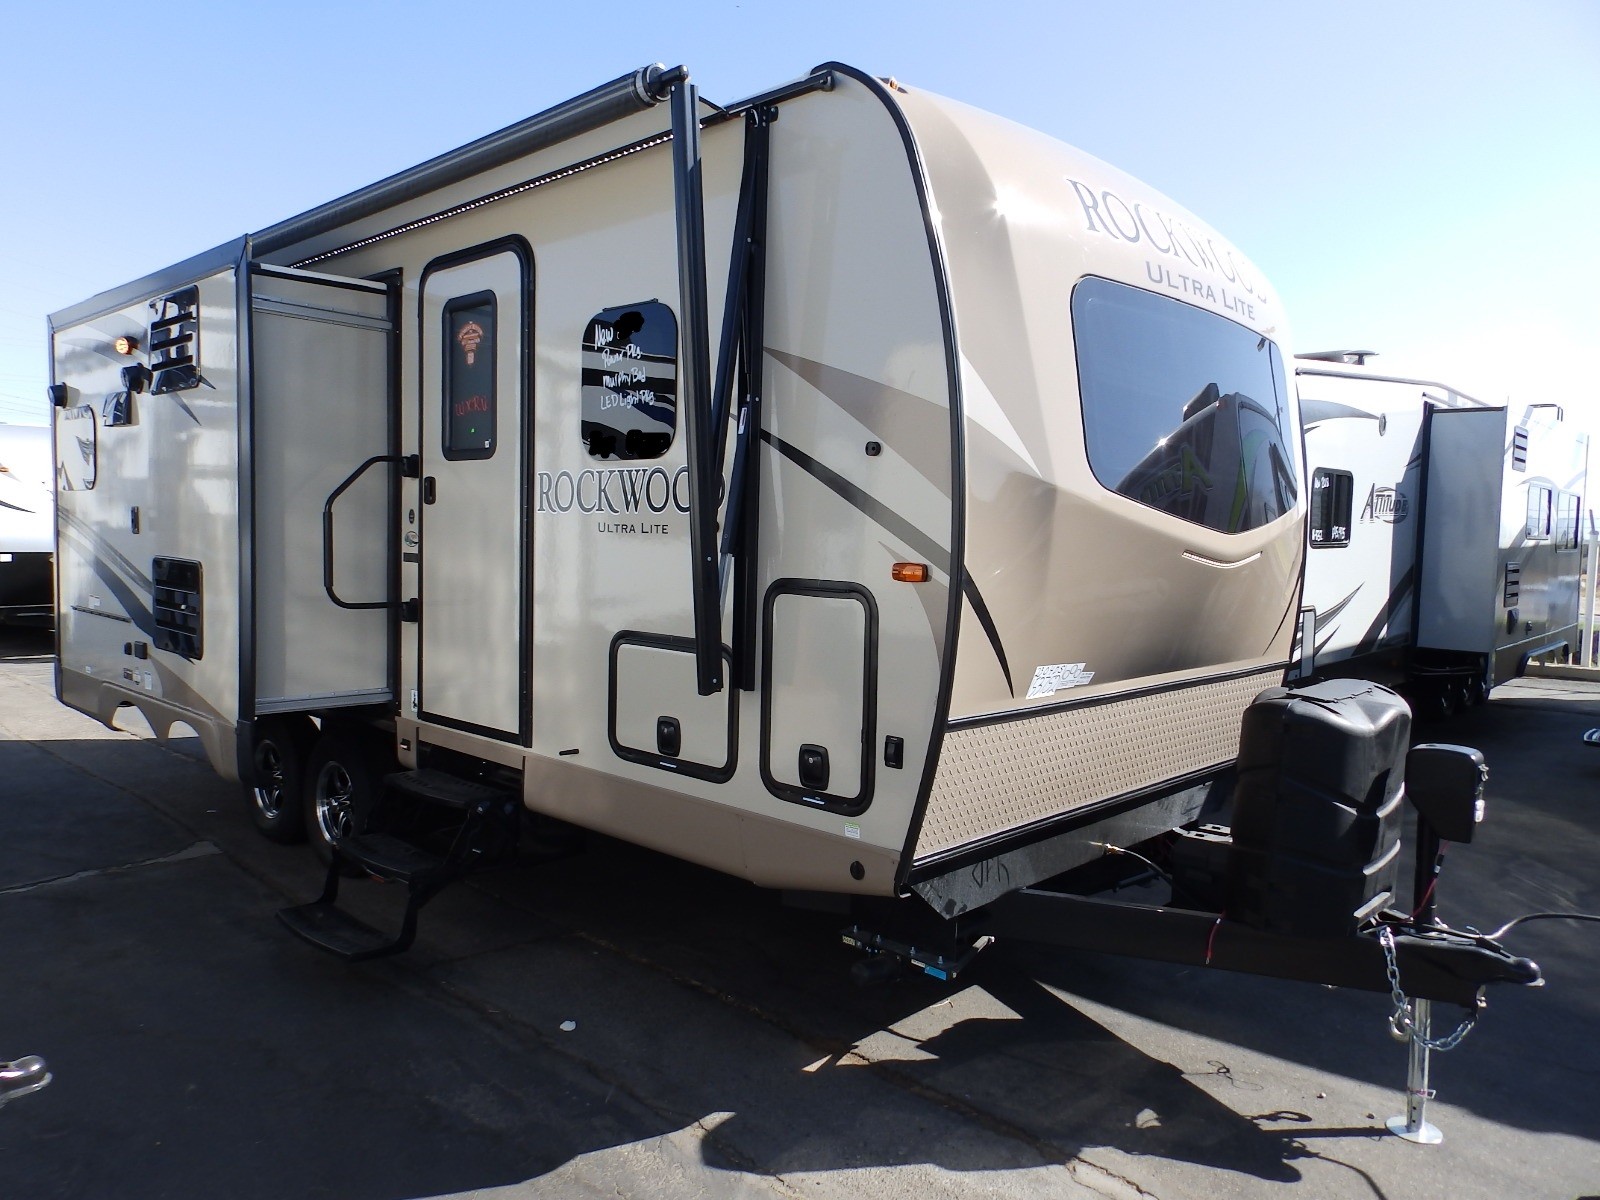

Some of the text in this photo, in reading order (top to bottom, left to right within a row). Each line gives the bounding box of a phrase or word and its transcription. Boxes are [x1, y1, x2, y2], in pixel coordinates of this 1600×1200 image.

[1065, 178, 1267, 304] ROCKWOO
[594, 323, 614, 351] New
[630, 366, 646, 383] Bed
[600, 393, 619, 411] LED
[619, 389, 640, 409] Light
[537, 465, 726, 515] ROCKWOO
[597, 522, 669, 535] ULTRA LITE
